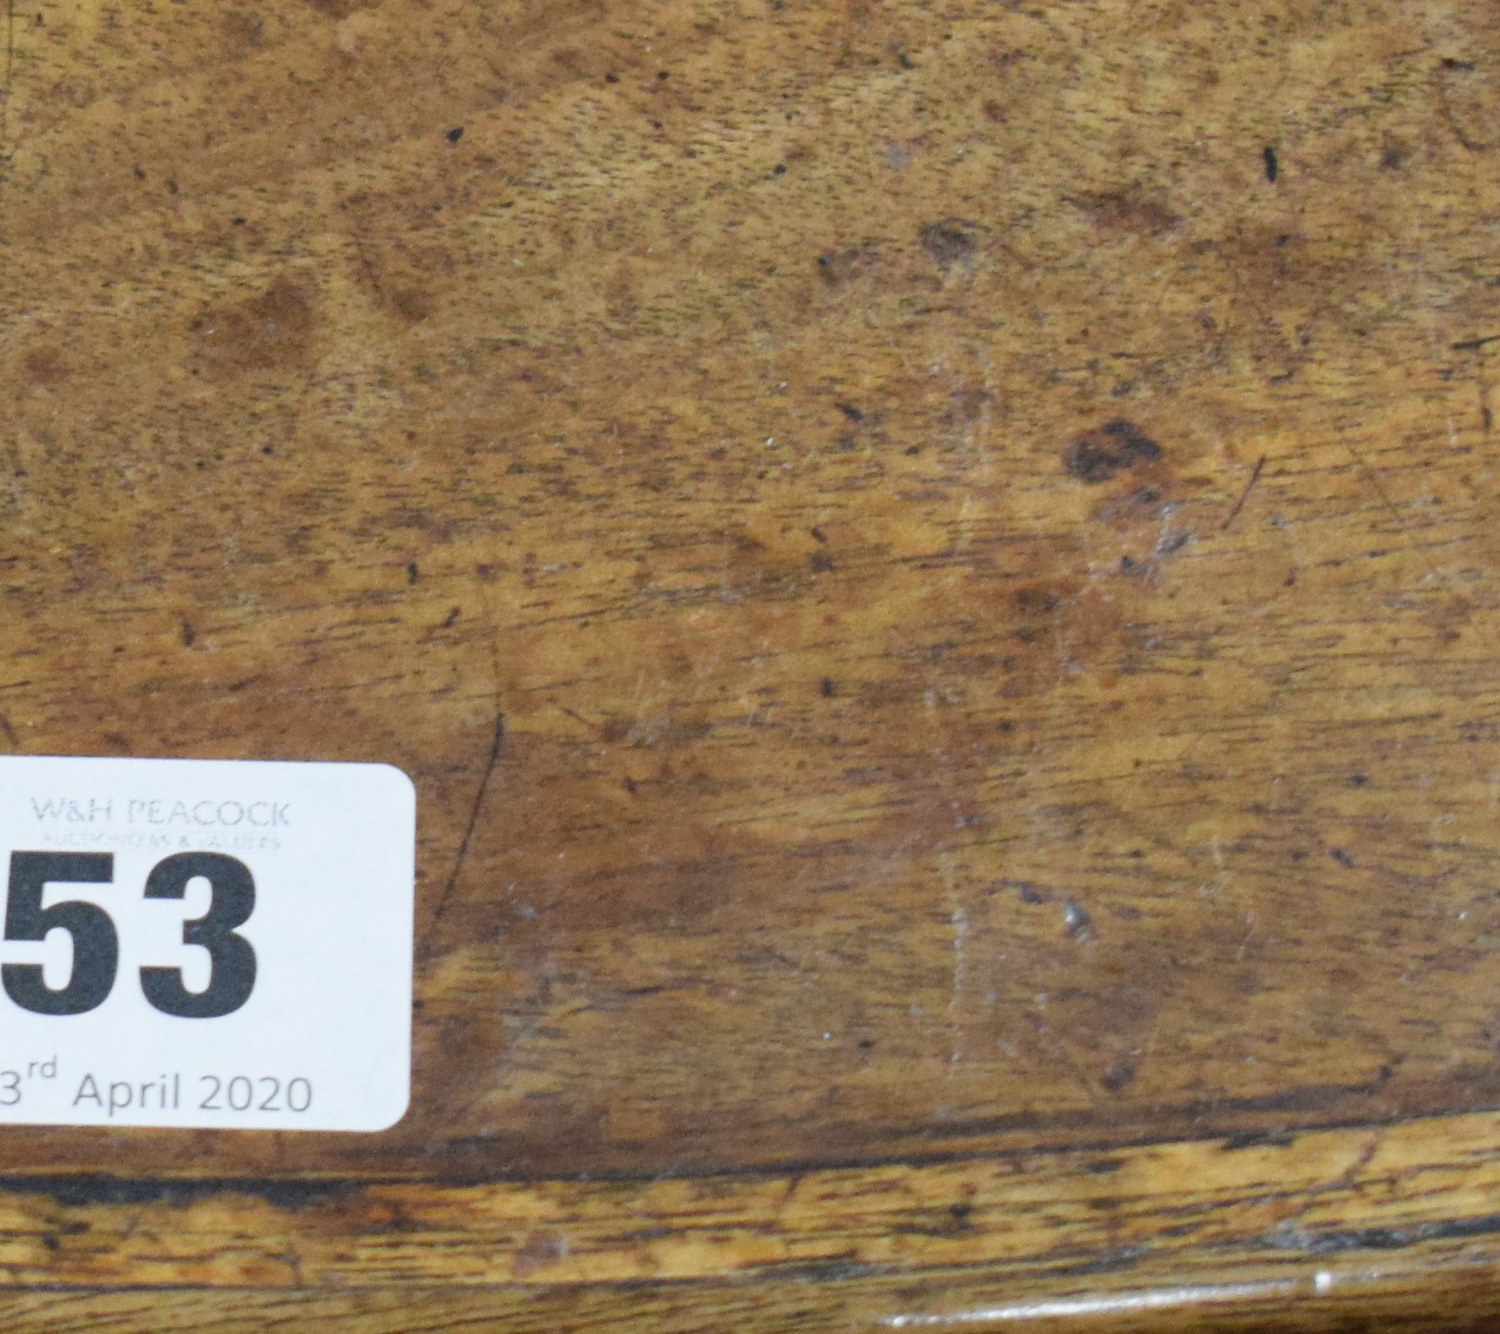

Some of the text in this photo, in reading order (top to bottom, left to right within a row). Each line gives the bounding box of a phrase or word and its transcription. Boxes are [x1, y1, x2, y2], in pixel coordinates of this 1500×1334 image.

[29, 796, 290, 827] W&H PEACOCK
[0, 850, 258, 1019] 53
[73, 1073, 182, 1116] April
[200, 1076, 313, 1113] 2020
